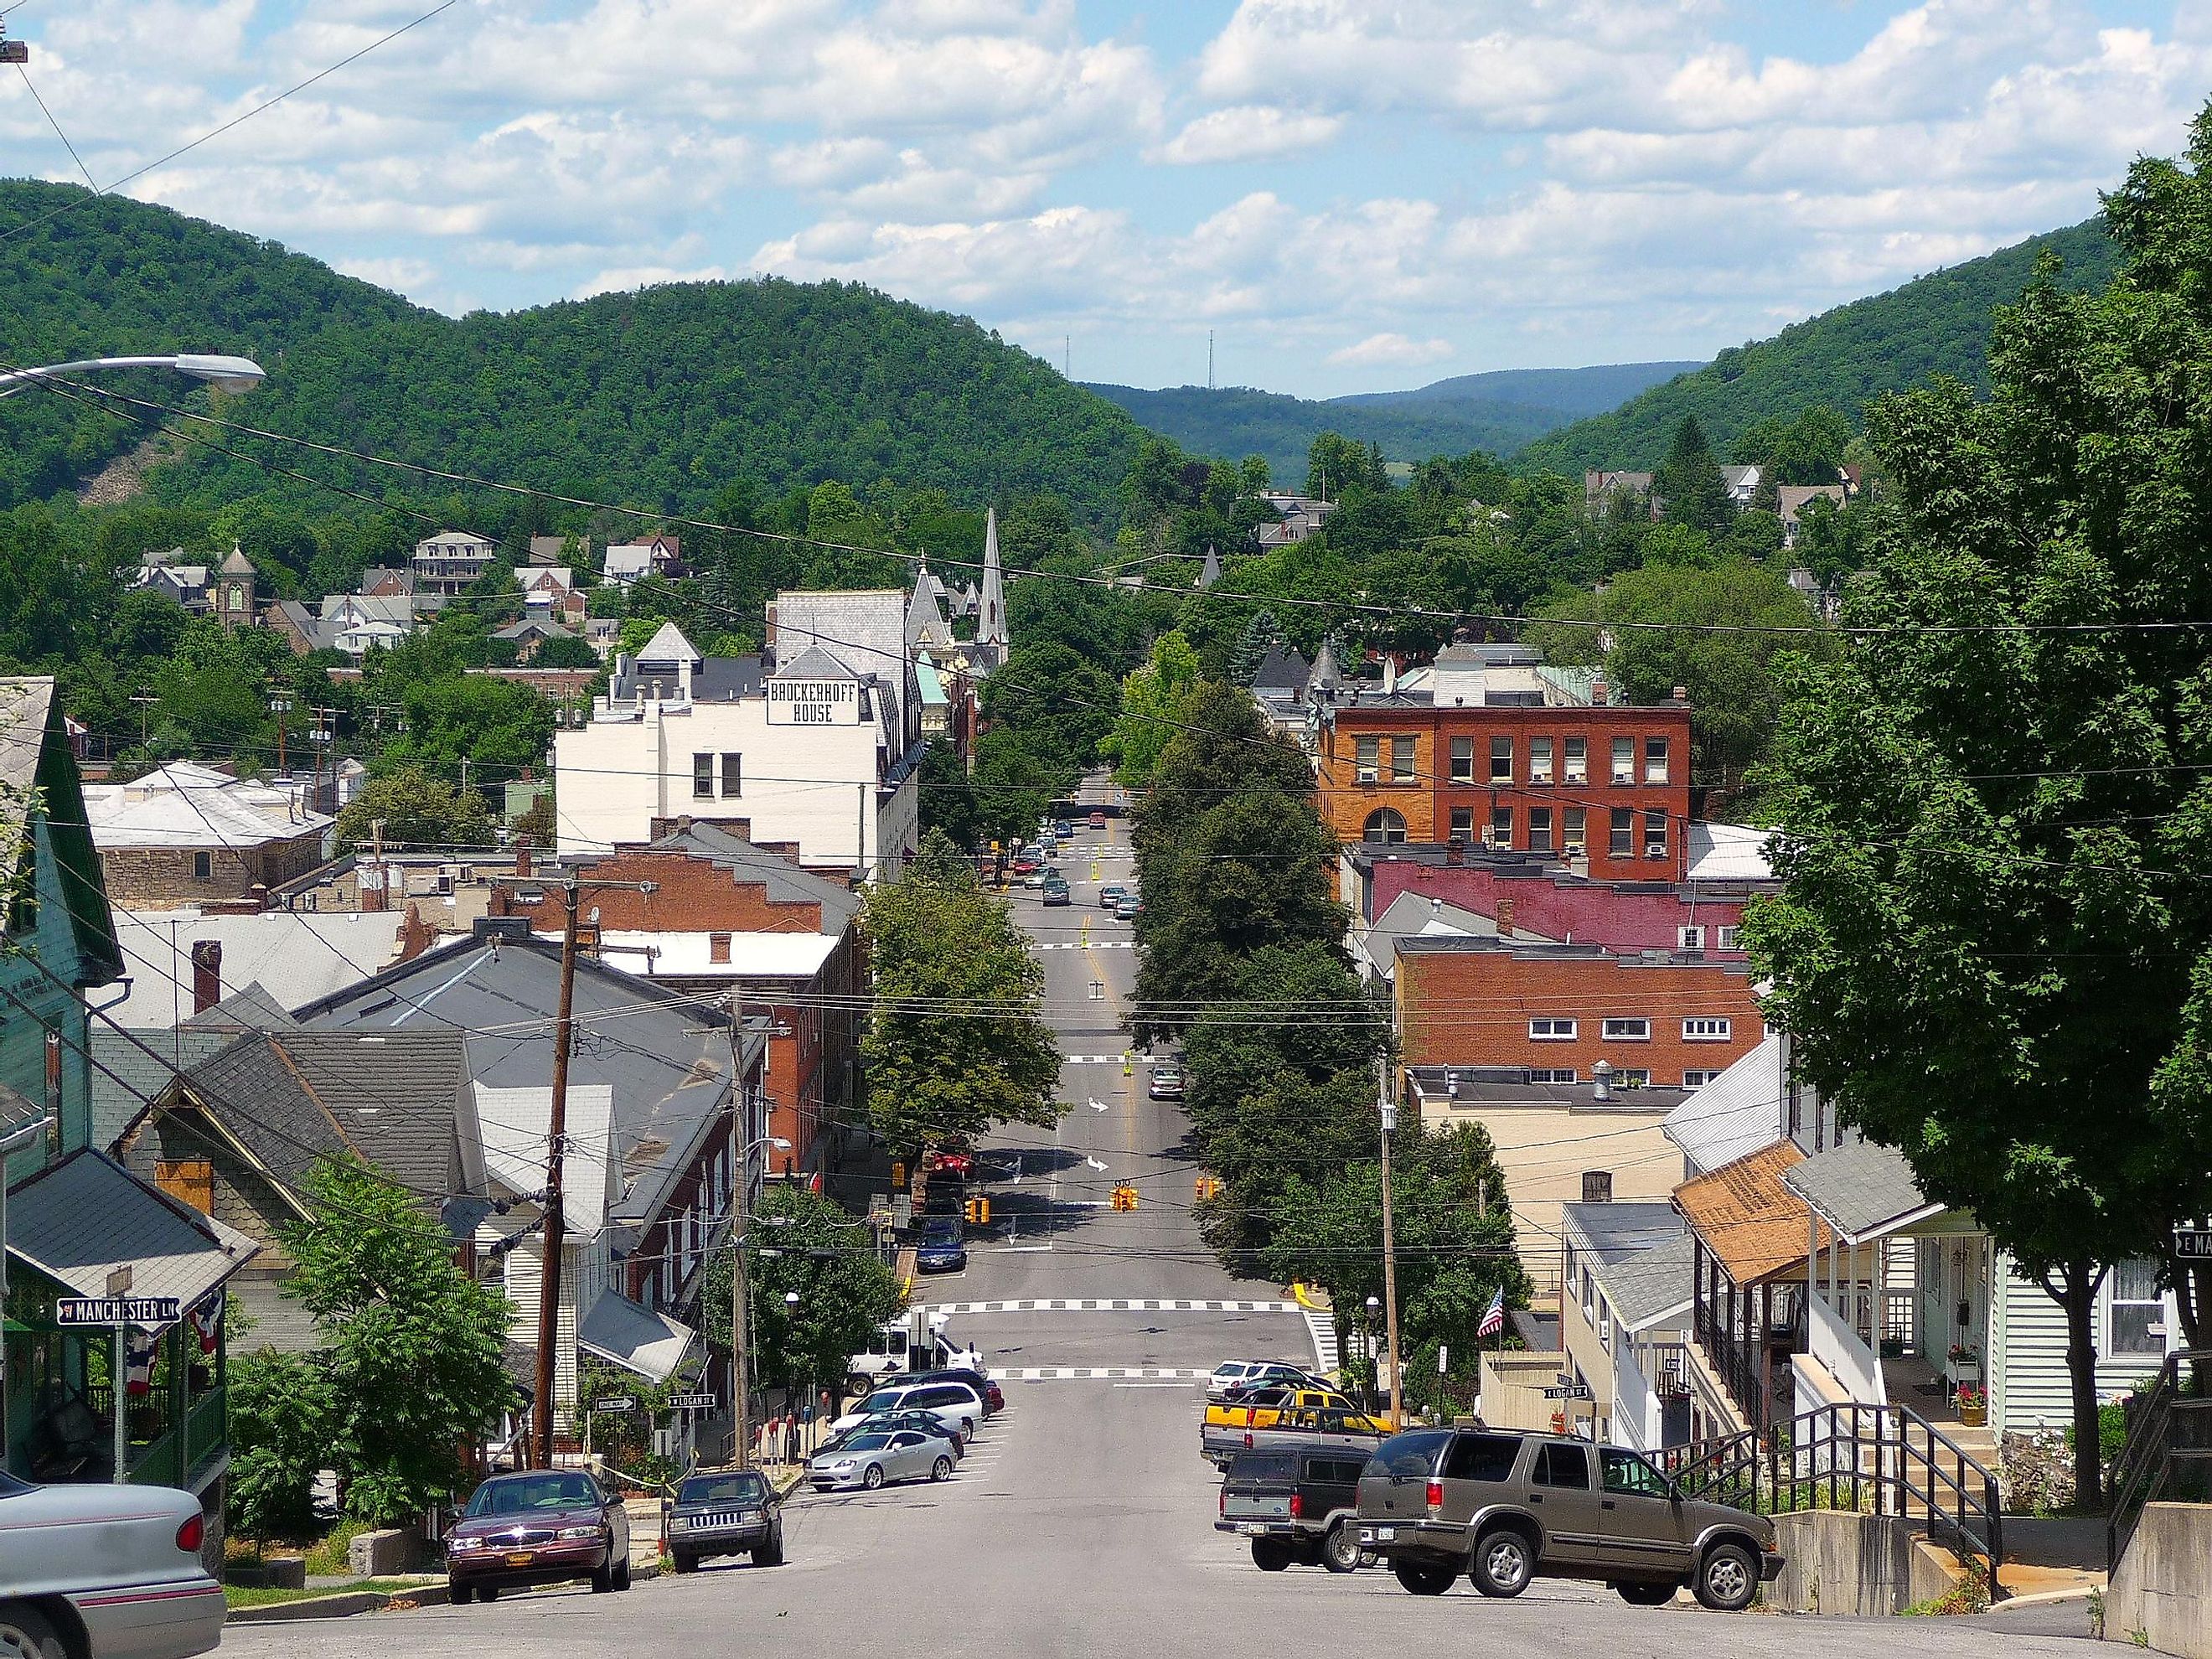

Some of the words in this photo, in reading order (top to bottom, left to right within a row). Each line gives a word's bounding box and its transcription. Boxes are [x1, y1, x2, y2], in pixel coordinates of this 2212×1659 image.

[771, 683, 855, 702] BROCKERHOFF
[793, 704, 832, 722] HOUSE
[2184, 1237, 2190, 1251] E
[76, 1300, 158, 1320] MANCHESTER
[162, 1302, 174, 1316] LN
[679, 1397, 702, 1406] LOGAN
[1553, 1389, 1575, 1398] LOGAN
